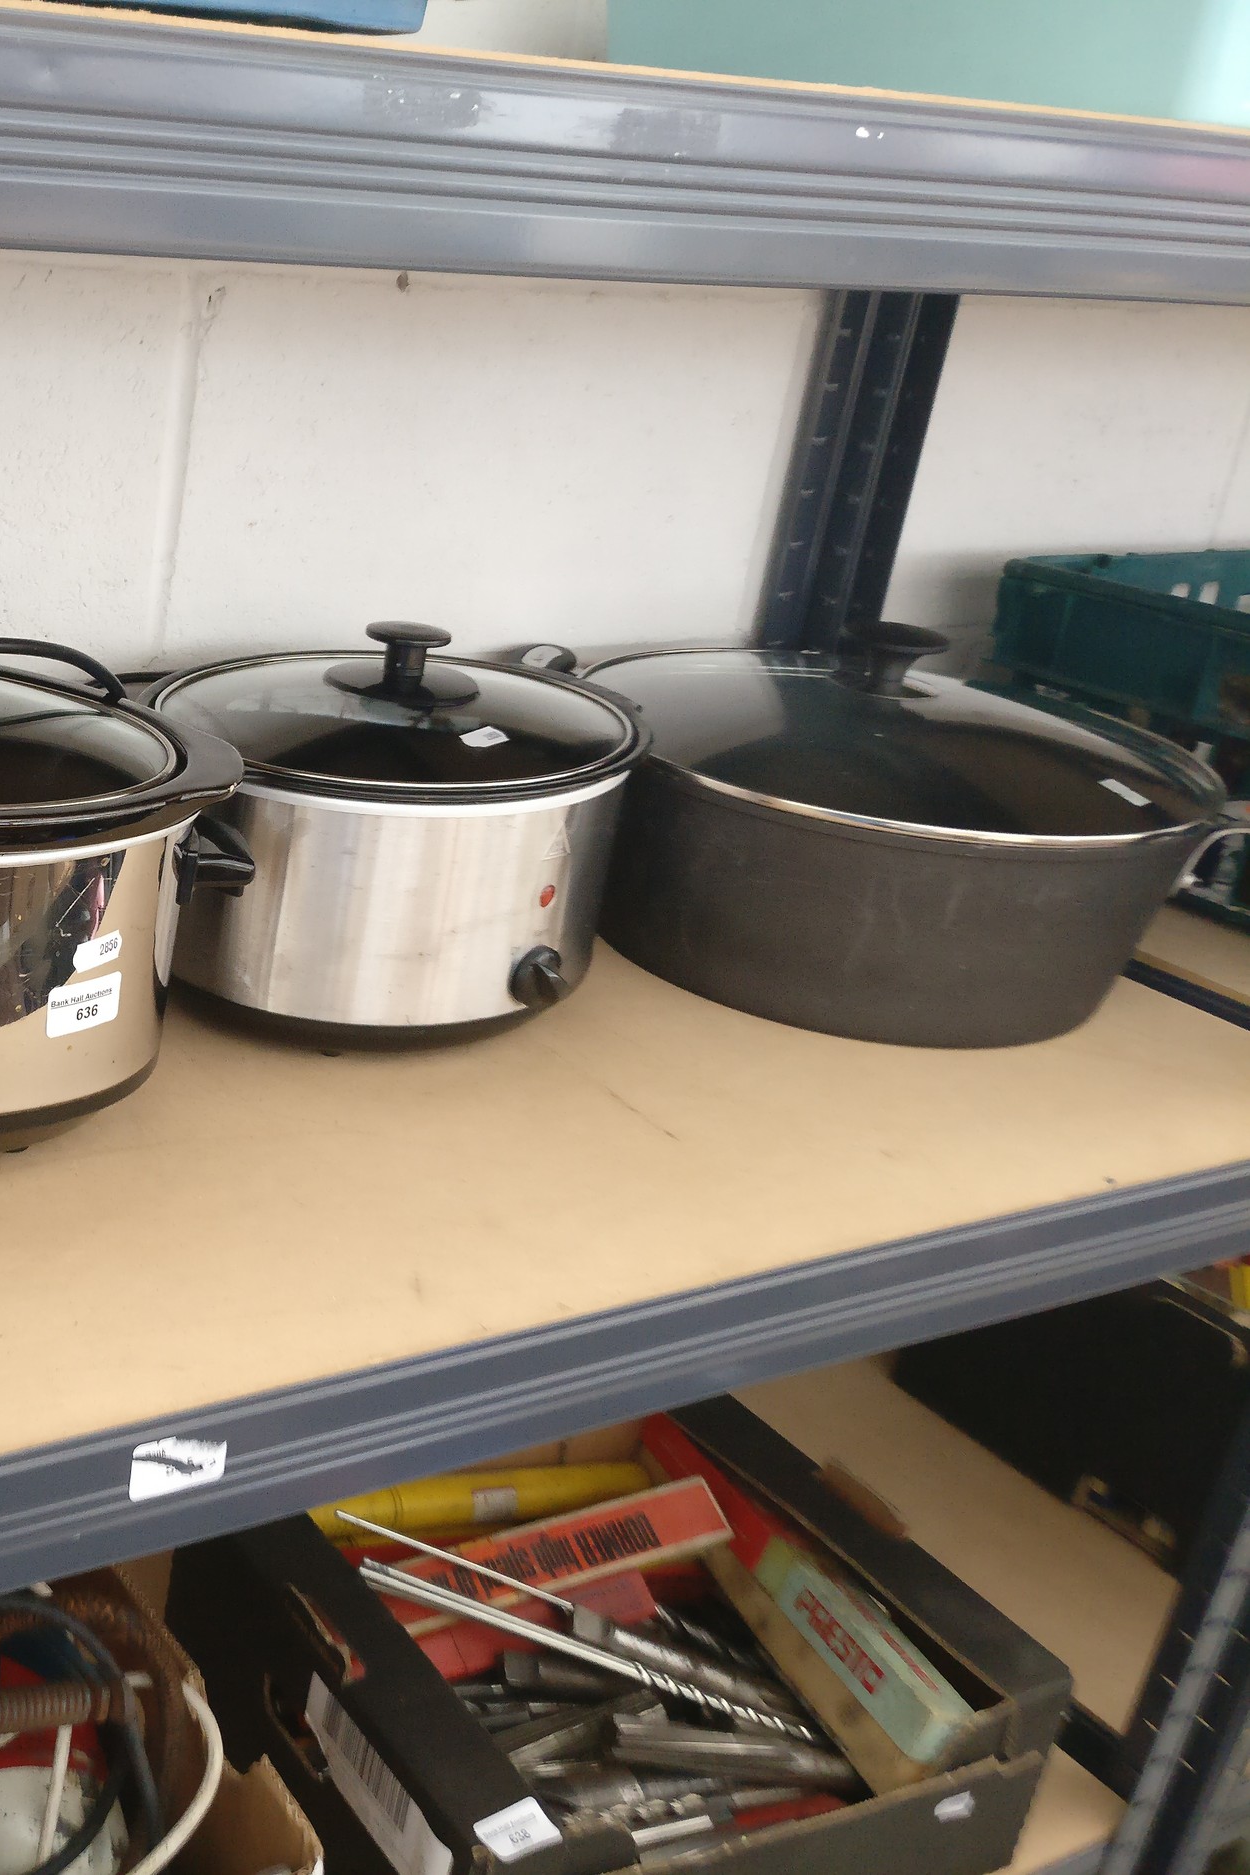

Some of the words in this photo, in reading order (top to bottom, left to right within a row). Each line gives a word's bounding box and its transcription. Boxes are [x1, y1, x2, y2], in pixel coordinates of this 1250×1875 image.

[99, 937, 119, 956] 2856
[51, 998, 69, 1008] Bank
[84, 988, 113, 1001] Auctions
[76, 1004, 99, 1021] 636
[572, 1510, 662, 1568] DORMER
[531, 1531, 584, 1580] high
